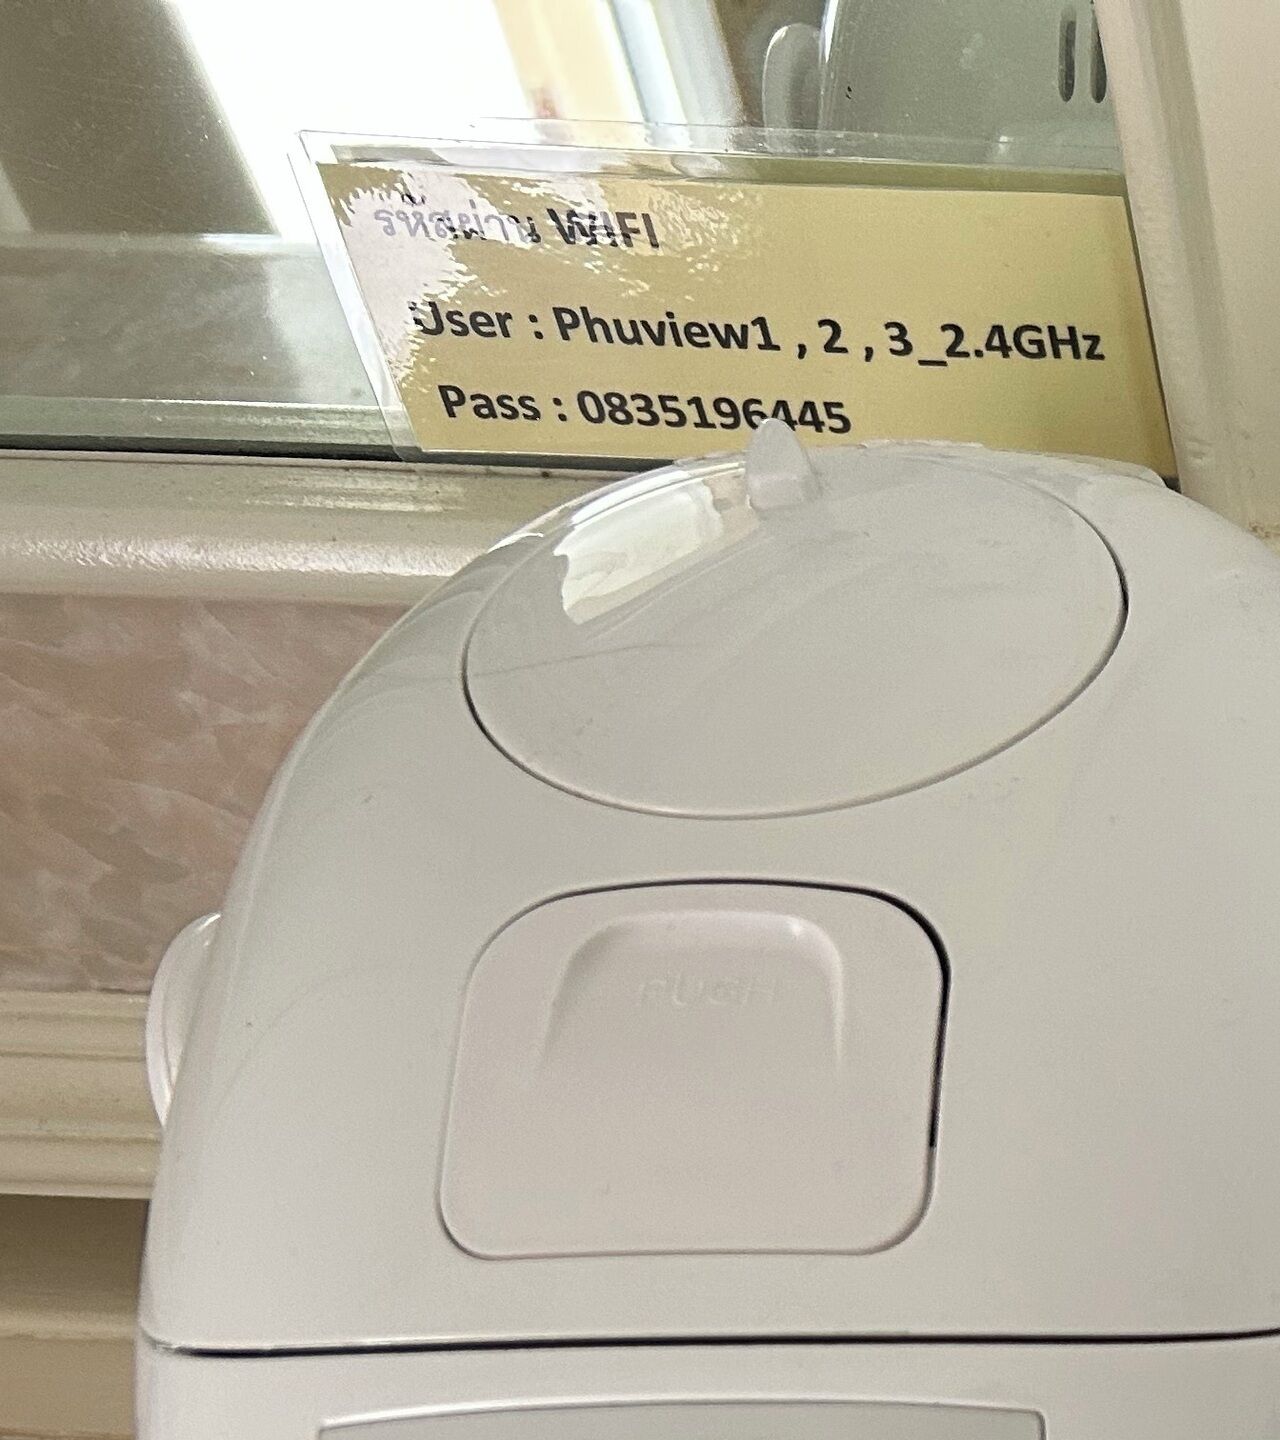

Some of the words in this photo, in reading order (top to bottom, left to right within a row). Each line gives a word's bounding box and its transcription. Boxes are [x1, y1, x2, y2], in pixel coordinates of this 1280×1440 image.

[408, 300, 514, 339] User
[552, 305, 781, 352] Phuview1
[883, 320, 1106, 367] 3_2.4GHz
[437, 383, 541, 421] Pass
[576, 389, 852, 434] 0835196445
